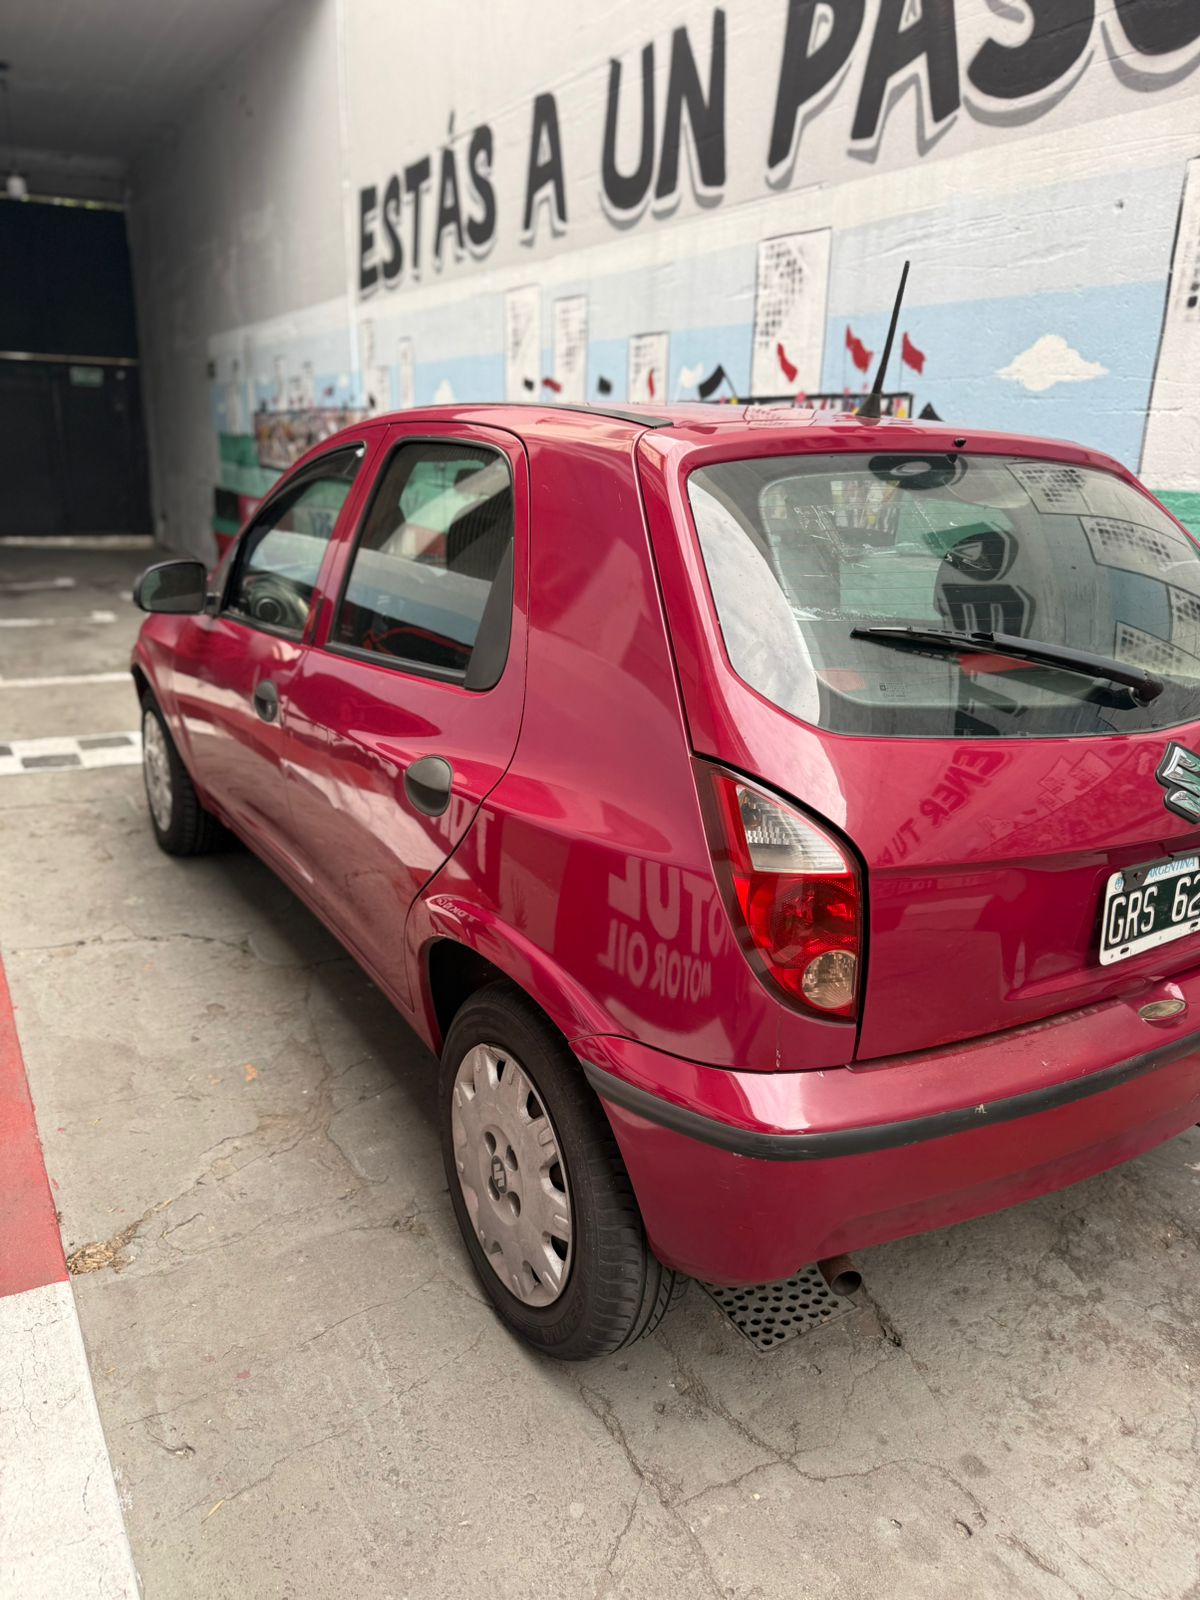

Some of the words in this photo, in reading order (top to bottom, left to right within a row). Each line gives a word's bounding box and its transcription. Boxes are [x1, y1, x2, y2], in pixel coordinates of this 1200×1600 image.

[358, 110, 497, 294] ESTÁS
[522, 91, 567, 239] A
[601, 7, 727, 216] UN
[1149, 857, 1195, 878] ARGENTINA
[1108, 885, 1158, 945] GRS
